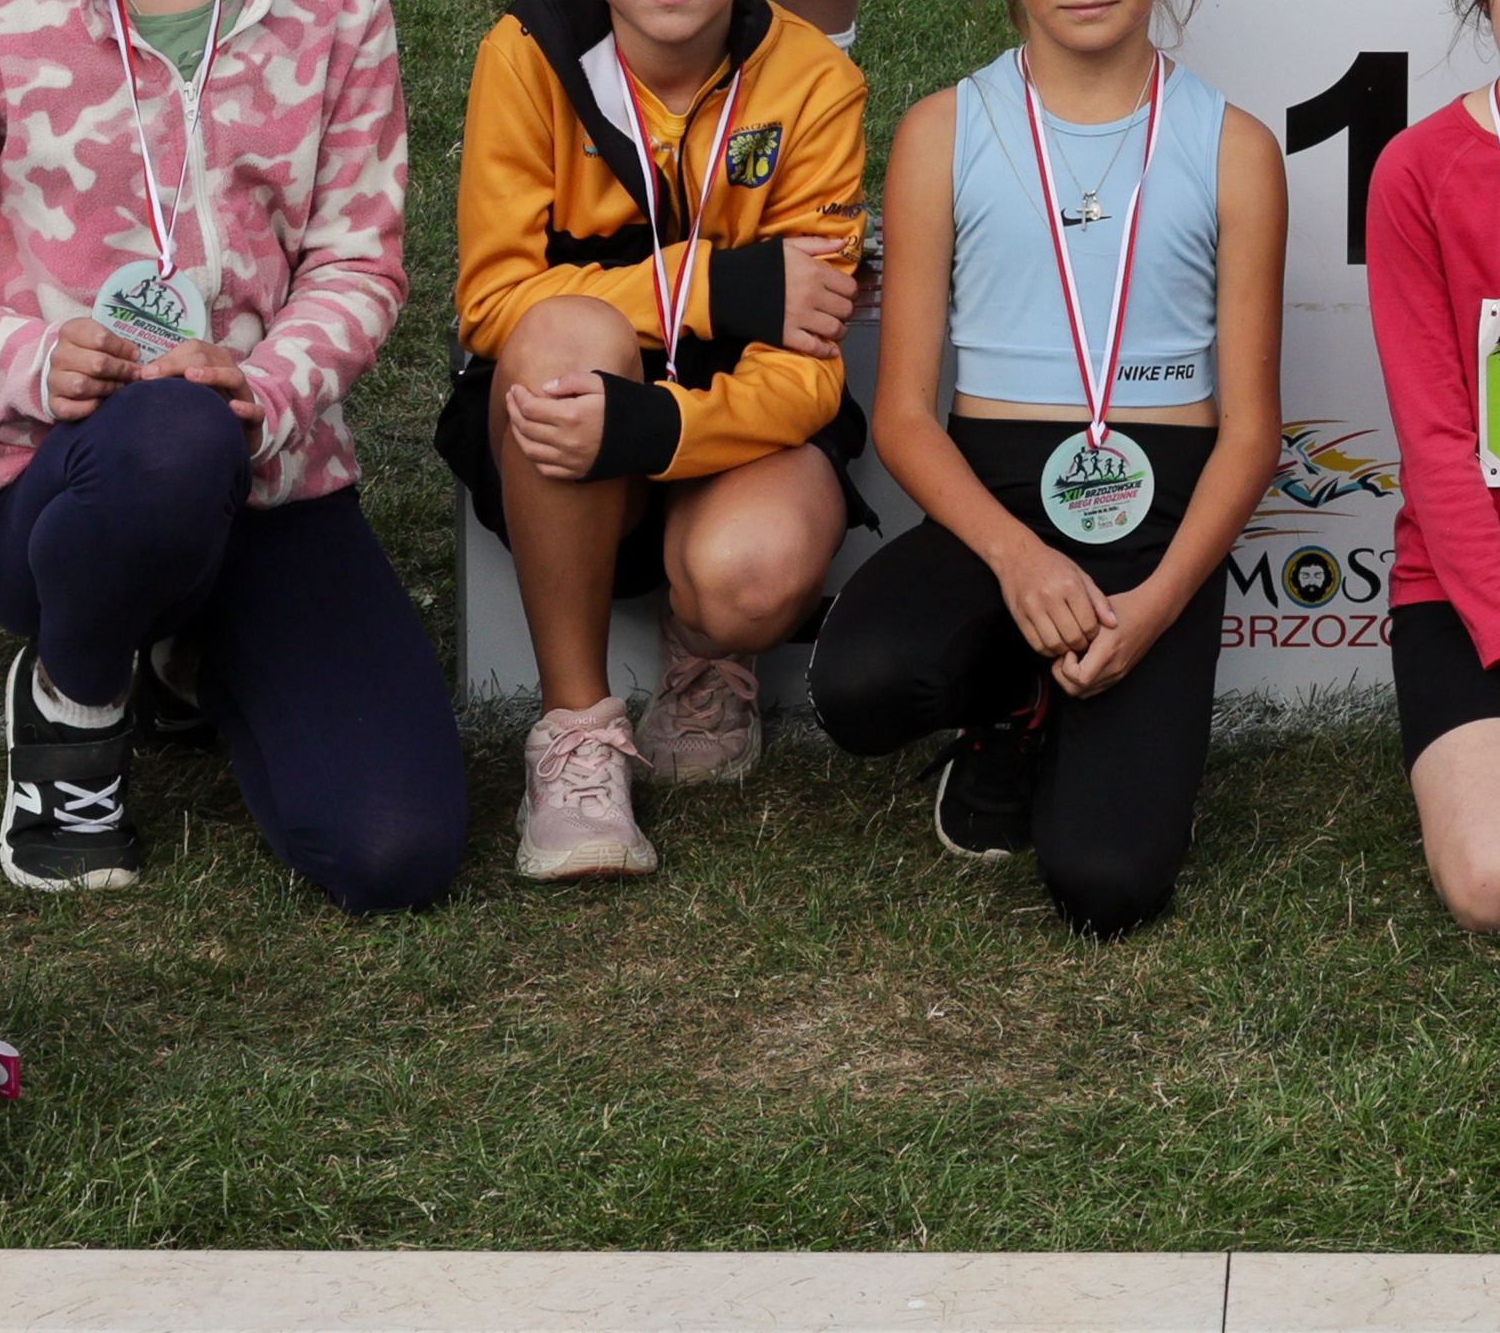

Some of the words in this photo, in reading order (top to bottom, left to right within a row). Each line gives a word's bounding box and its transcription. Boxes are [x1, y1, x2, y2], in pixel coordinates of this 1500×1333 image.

[1286, 51, 1408, 265] 1
[112, 320, 138, 334] BIEGI
[1117, 363, 1161, 382] NIKE
[1164, 363, 1195, 381] PRO
[1085, 479, 1143, 499] BRZOZOWSKIE
[1068, 499, 1092, 510] BIEGI
[1093, 489, 1139, 506] RODZINNE
